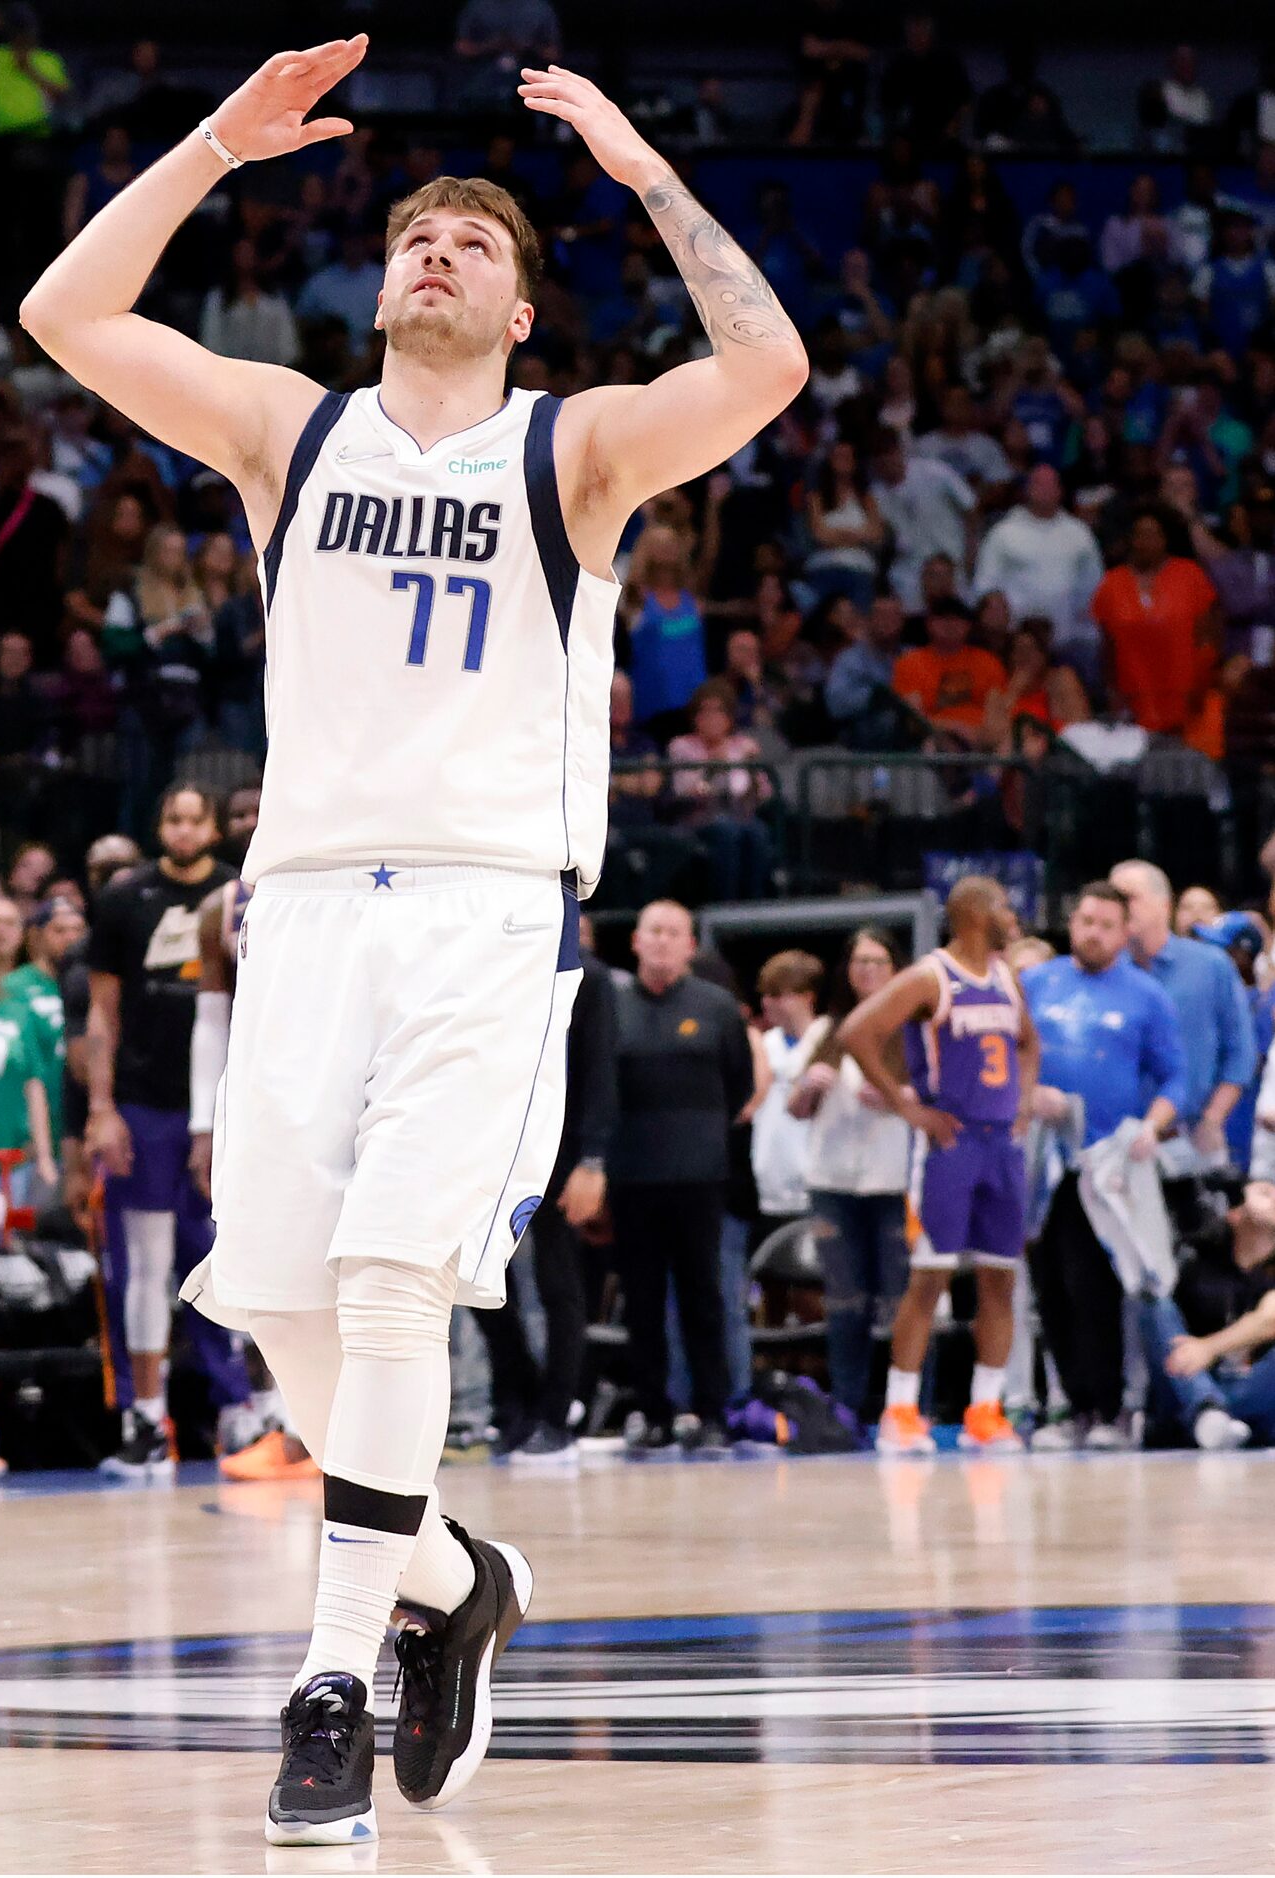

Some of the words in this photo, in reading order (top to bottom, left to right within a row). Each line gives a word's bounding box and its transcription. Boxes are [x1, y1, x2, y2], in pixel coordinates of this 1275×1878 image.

[314, 491, 503, 564] DALLAS
[390, 570, 493, 673] 77
[980, 1034, 1008, 1088] 3
